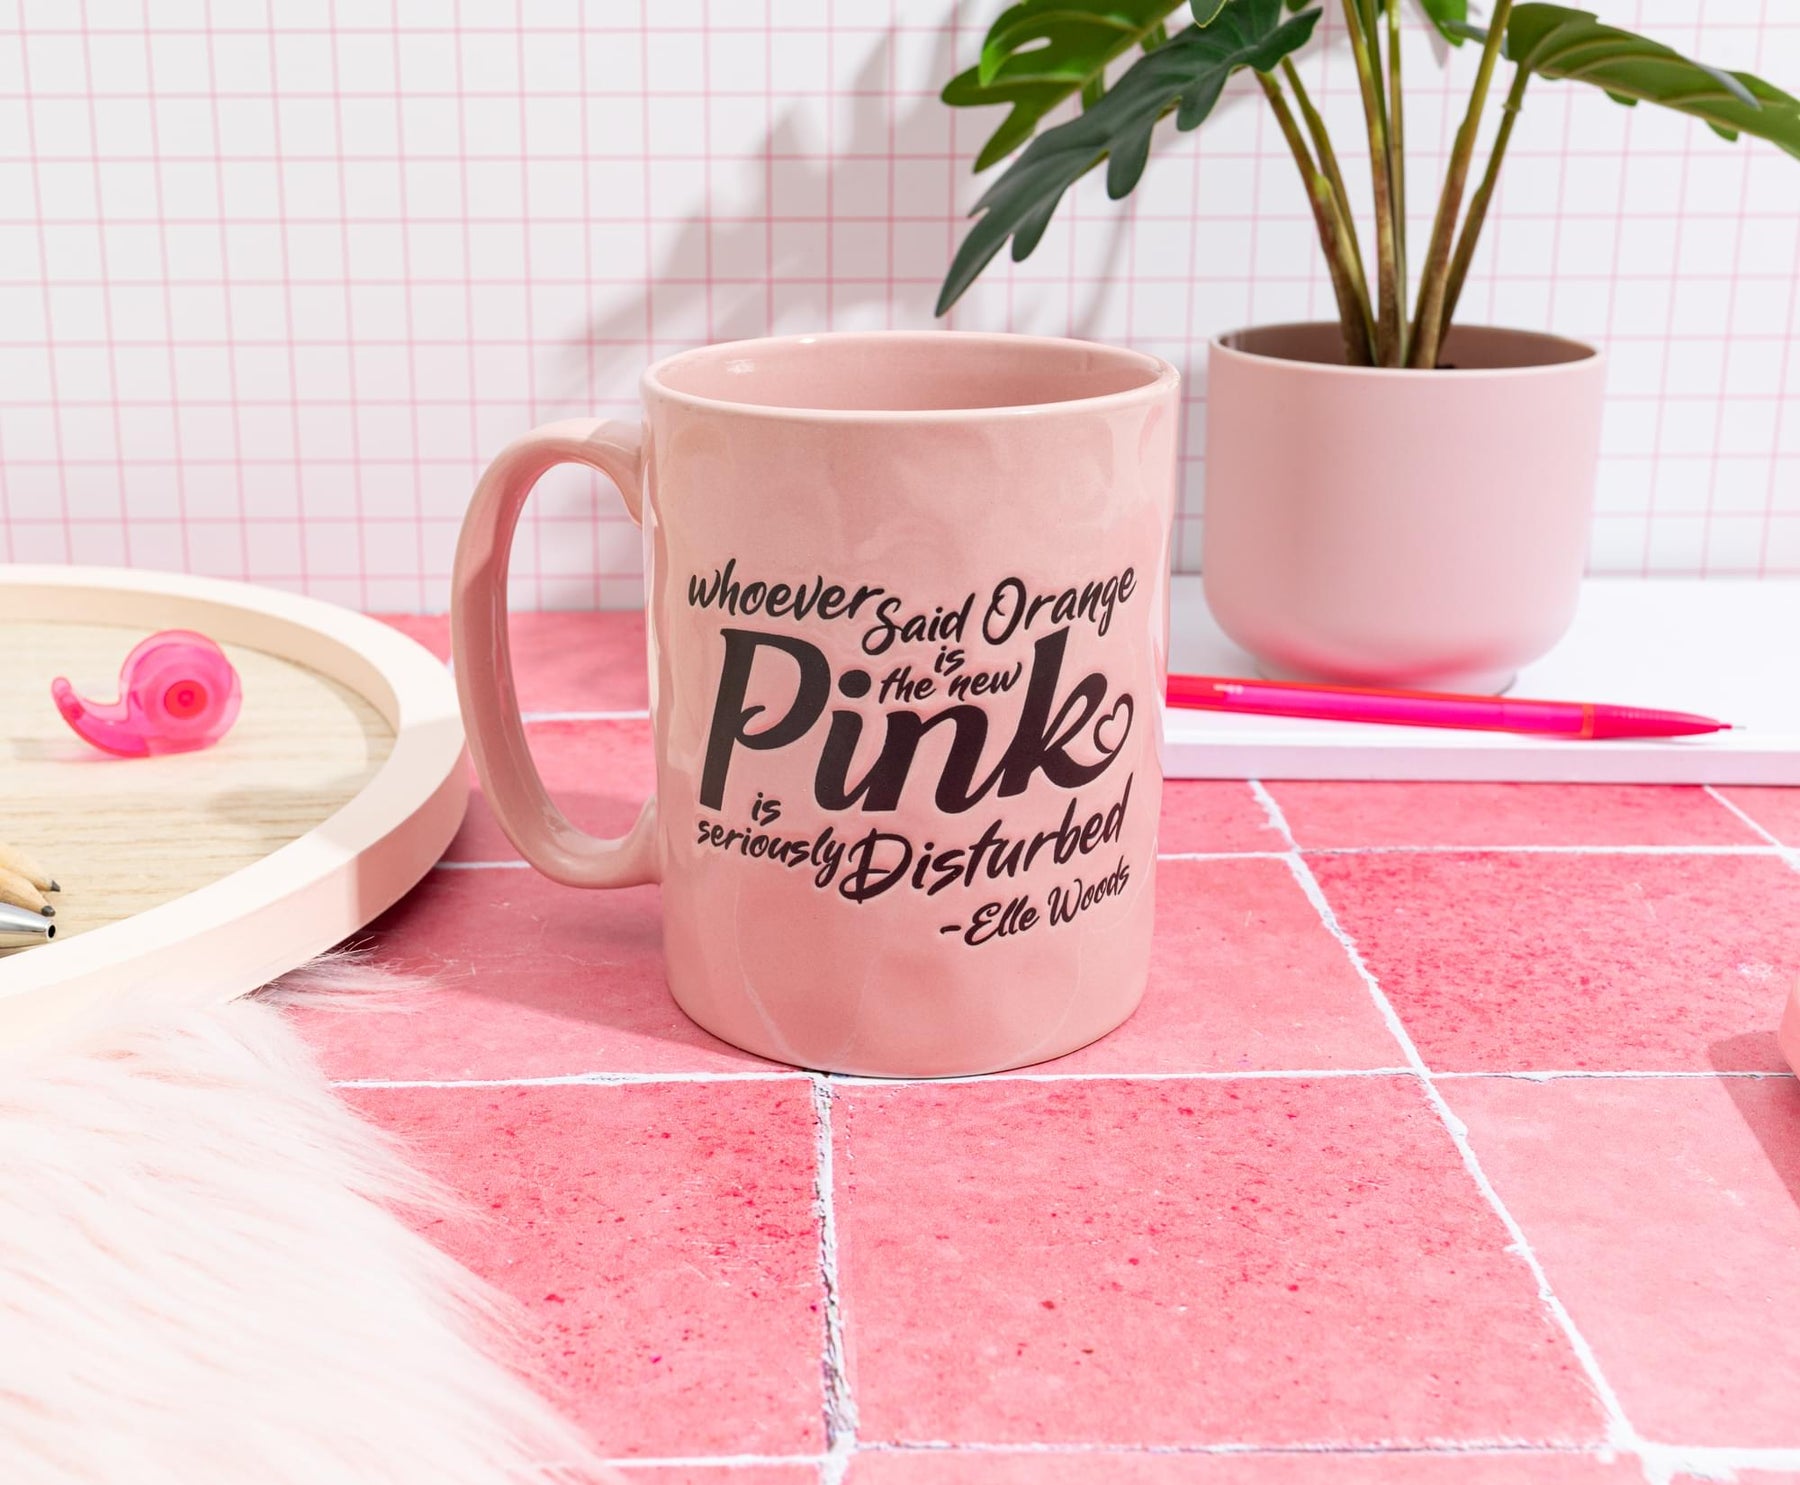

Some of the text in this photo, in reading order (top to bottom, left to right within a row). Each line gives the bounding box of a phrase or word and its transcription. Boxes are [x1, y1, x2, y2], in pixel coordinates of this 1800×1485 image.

[861, 592, 976, 656] Said
[982, 567, 1137, 646] Orange
[878, 661, 1023, 704] the new
[934, 644, 966, 676] is
[700, 626, 1134, 814] Pink
[697, 772, 1134, 904] seriously Disturbed
[751, 791, 782, 827] is
[1047, 855, 1131, 927] Woods
